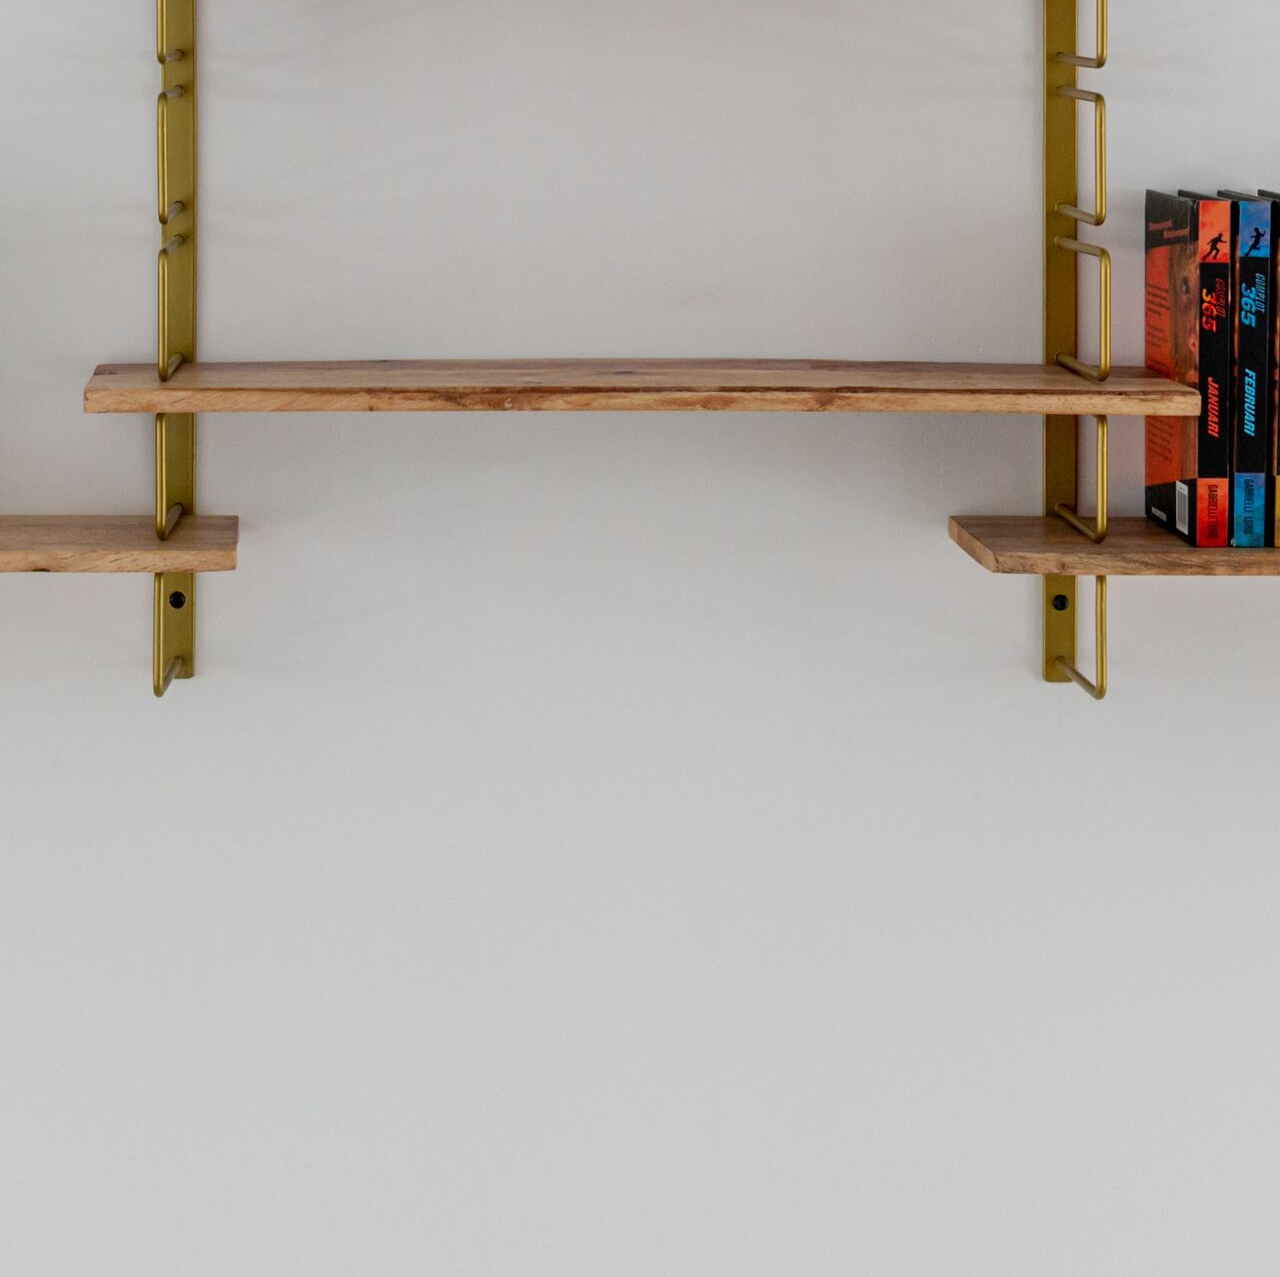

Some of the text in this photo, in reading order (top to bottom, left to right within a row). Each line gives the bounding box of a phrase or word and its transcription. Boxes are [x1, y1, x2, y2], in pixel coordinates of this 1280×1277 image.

[1201, 287, 1217, 334] 365
[1241, 282, 1257, 329] 365
[1255, 272, 1266, 315] COMPLOT
[1207, 376, 1220, 439] JANUARI
[1244, 367, 1257, 438] FEBRUARI
[1207, 484, 1219, 520] GABRIELLE
[1243, 478, 1255, 514] GABRIELLE
